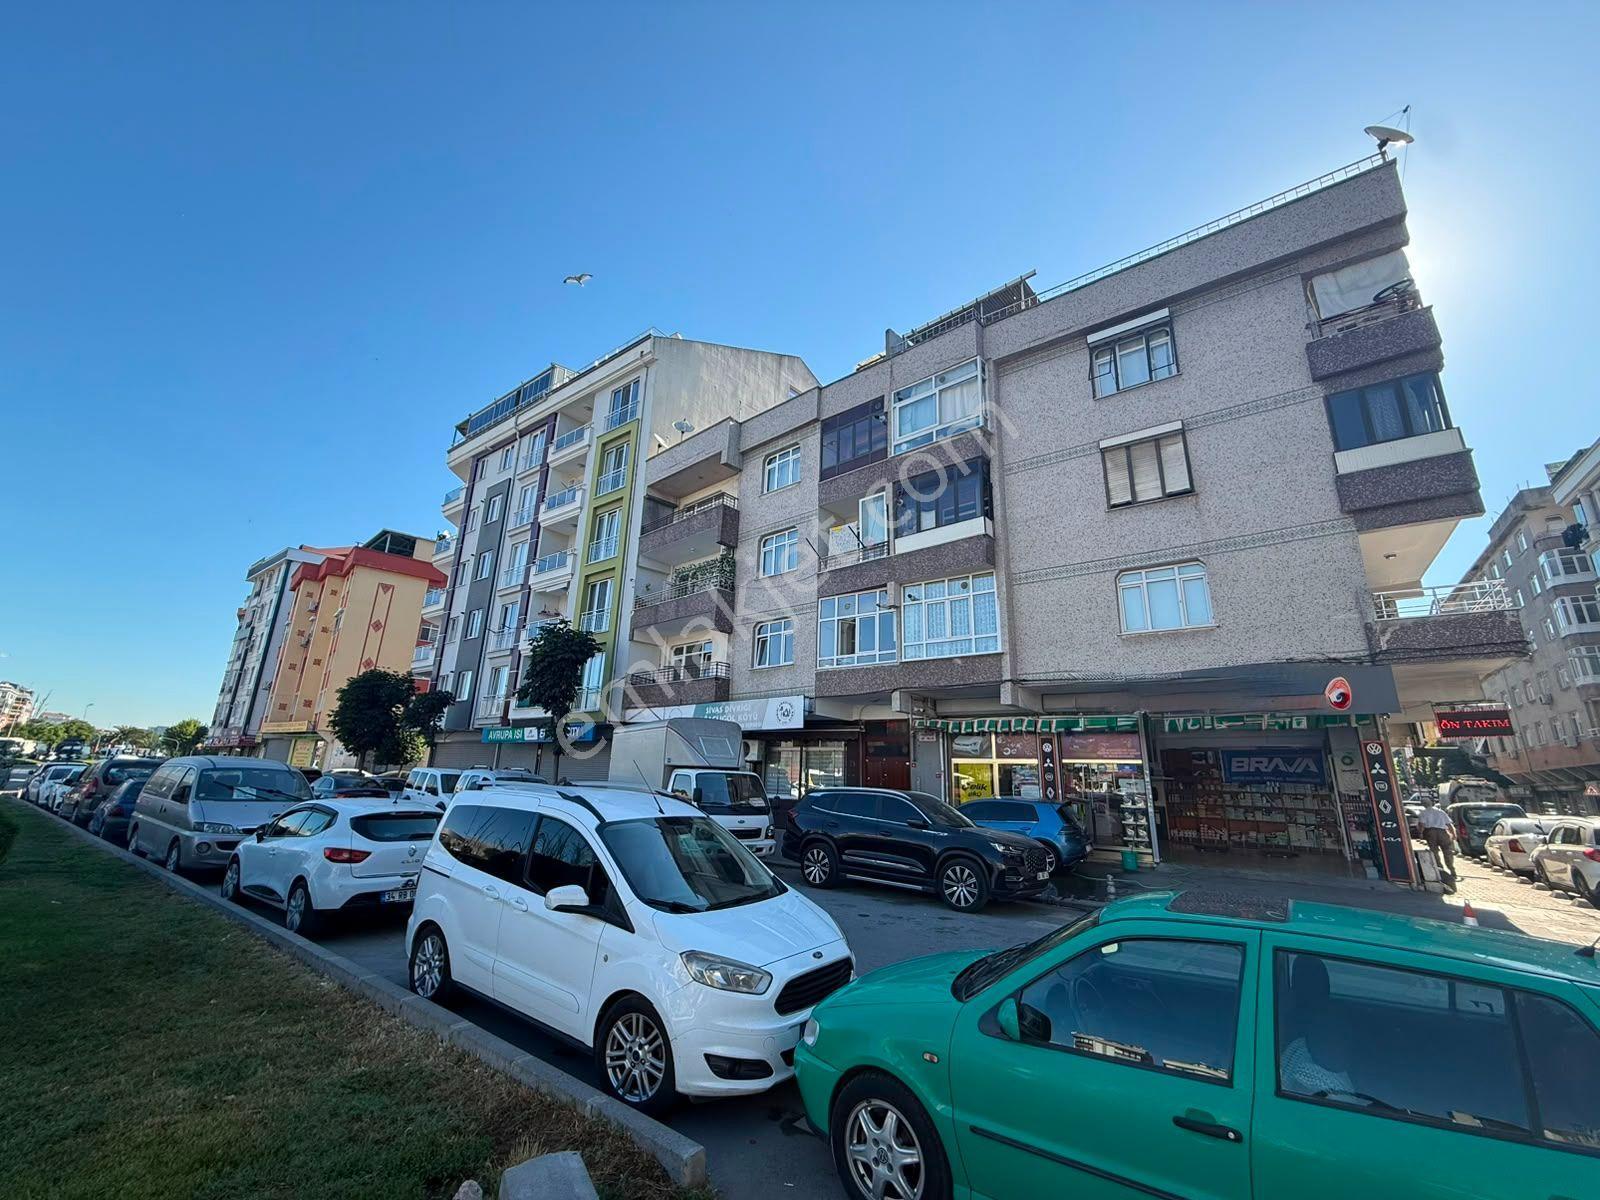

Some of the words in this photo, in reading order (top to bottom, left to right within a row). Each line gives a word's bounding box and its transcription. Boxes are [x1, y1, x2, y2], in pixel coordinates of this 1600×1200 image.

[1440, 719, 1460, 729] ÖN
[1463, 719, 1510, 729] TAKIM
[487, 730, 512, 740] AVRUPA
[1231, 757, 1319, 773] BRAVA
